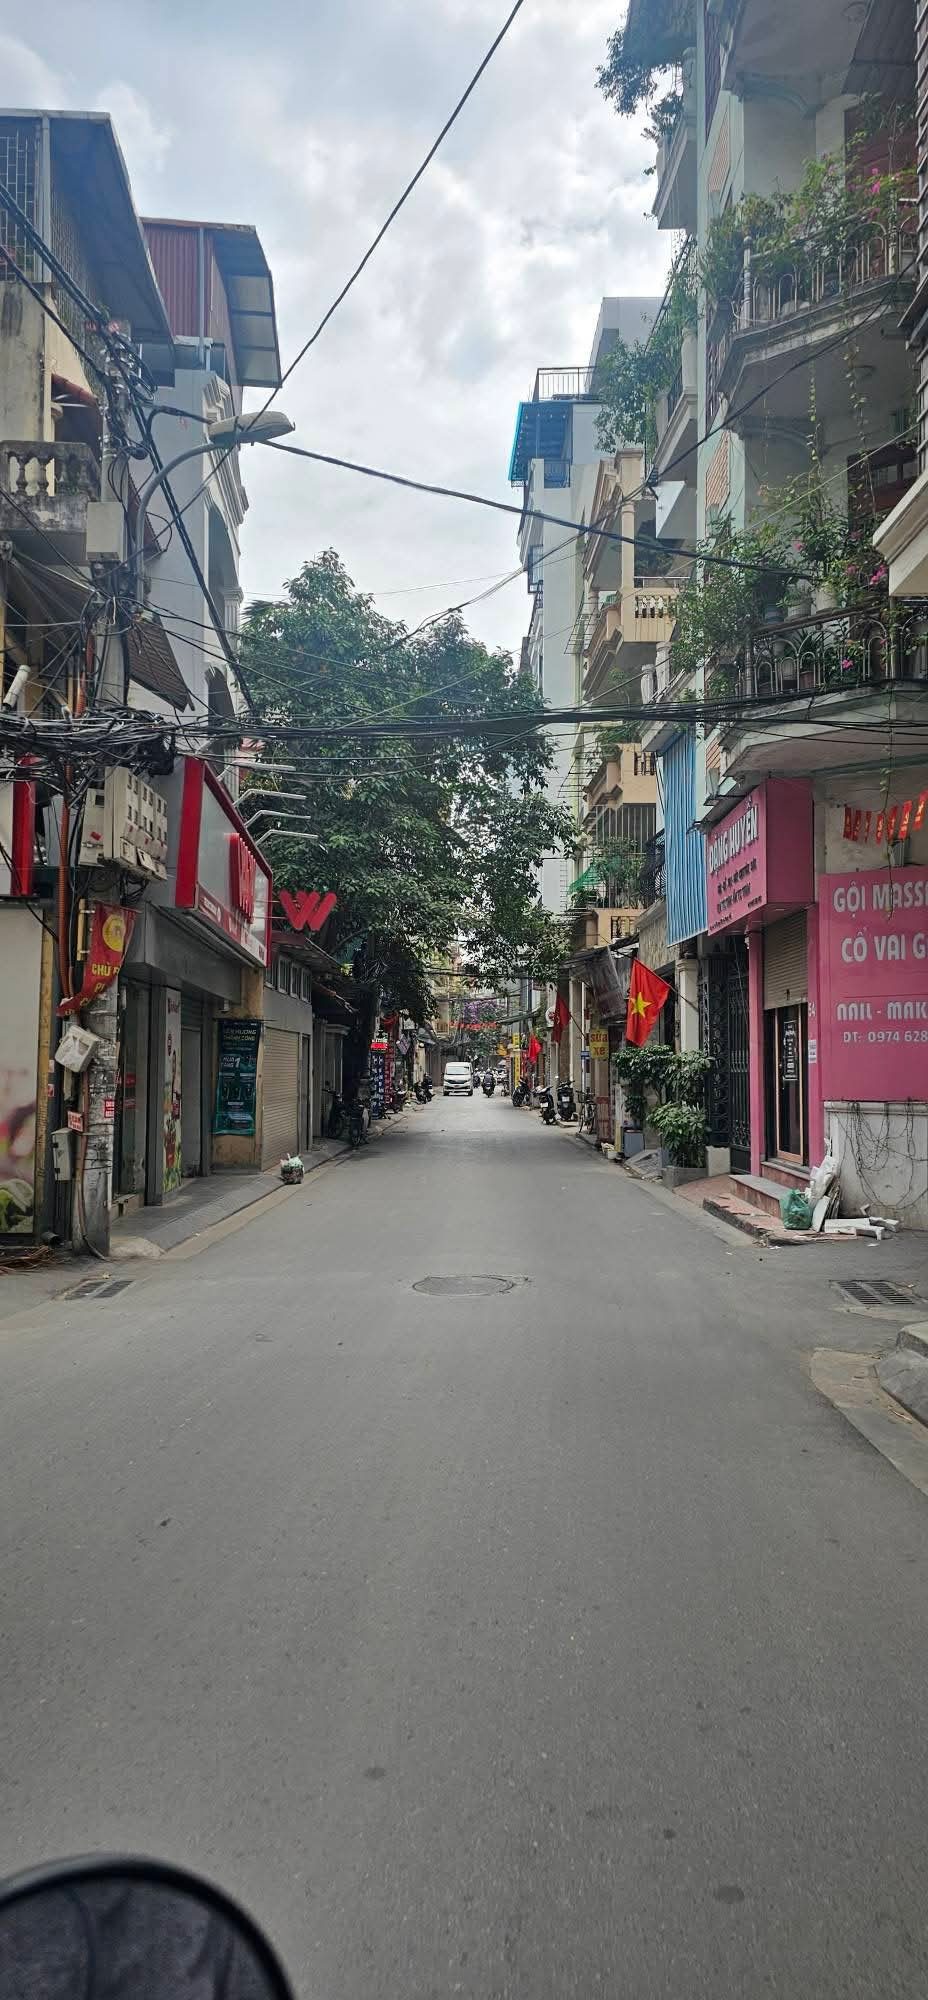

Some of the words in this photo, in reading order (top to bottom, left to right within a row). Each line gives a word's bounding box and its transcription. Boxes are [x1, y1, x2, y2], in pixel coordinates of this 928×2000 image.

[874, 934, 906, 961] VAI
[837, 1002, 872, 1021] NAIL
[868, 1031, 900, 1042] 0974
